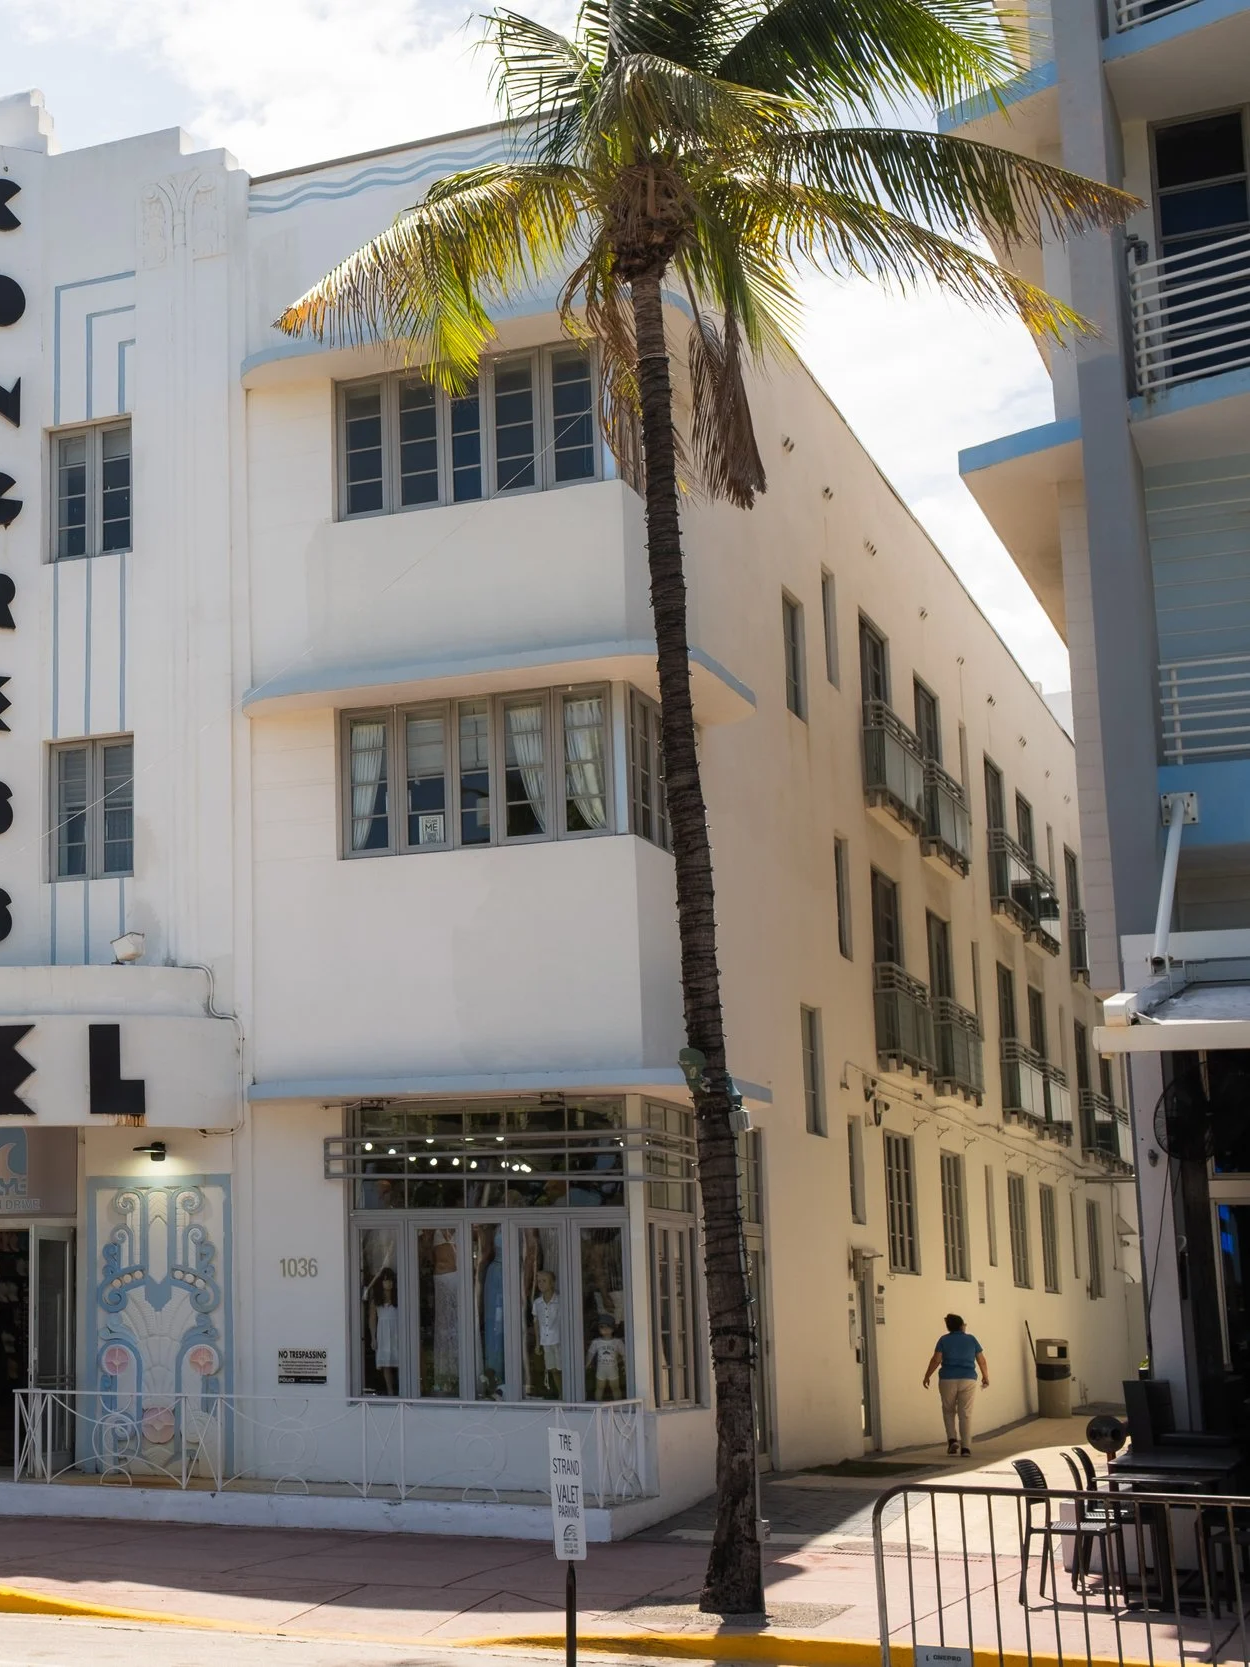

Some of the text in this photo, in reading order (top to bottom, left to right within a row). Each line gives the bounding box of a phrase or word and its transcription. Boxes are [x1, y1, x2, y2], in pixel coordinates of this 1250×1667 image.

[425, 823, 438, 831] ME
[6, 1198, 40, 1210] DRIVE
[280, 1258, 318, 1278] 1036
[278, 1350, 327, 1359] NO TRESPASSING
[552, 1458, 580, 1476] STRAND
[556, 1483, 580, 1504] VALET
[558, 1505, 580, 1519] PARKING
